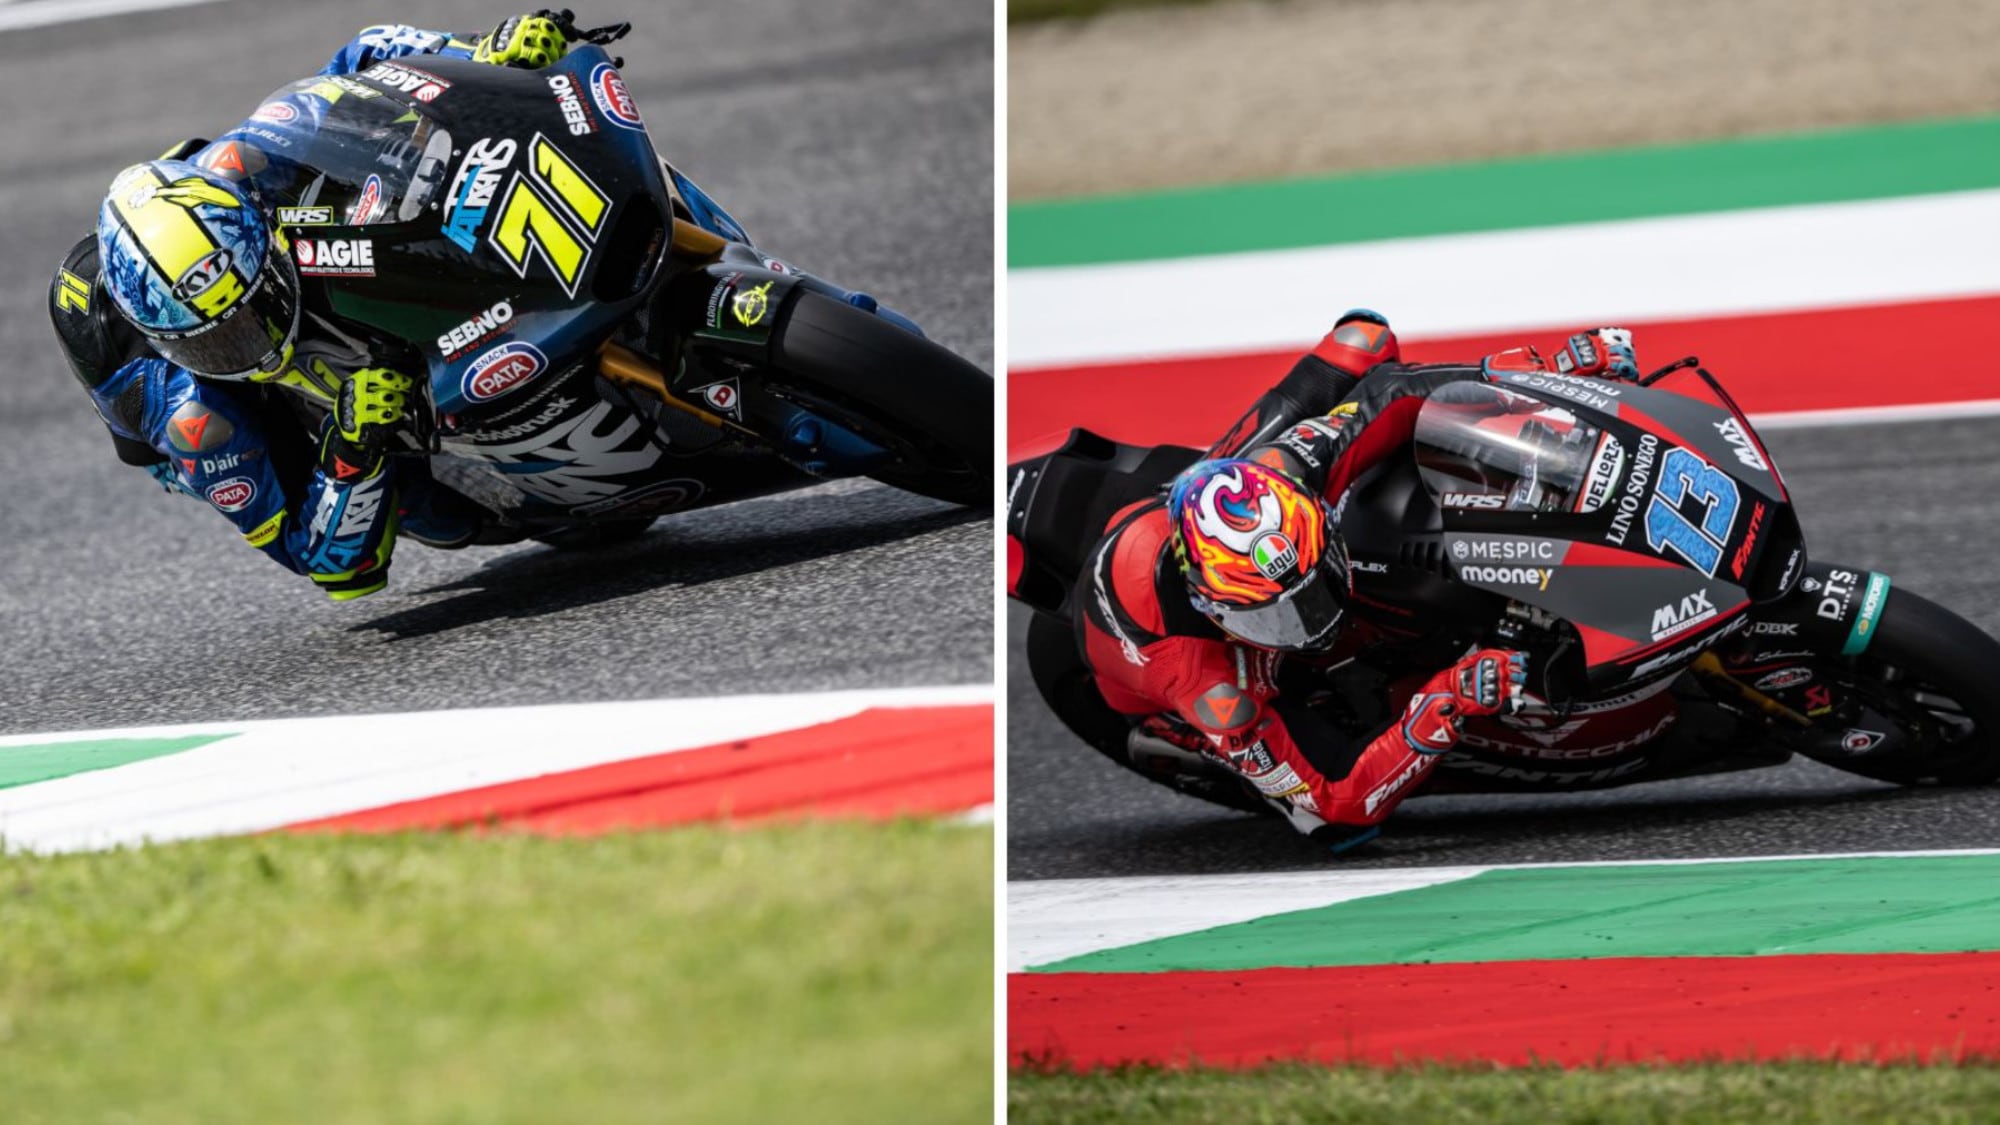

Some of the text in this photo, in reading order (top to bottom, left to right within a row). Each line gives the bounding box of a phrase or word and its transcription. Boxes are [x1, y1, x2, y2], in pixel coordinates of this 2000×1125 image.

[361, 64, 427, 92] AGIE
[280, 208, 330, 223] WRS
[488, 131, 613, 300] 71
[315, 239, 375, 267] AGIE
[56, 266, 91, 316] 71
[180, 254, 226, 299] KYT
[475, 346, 508, 371] SNACK
[478, 360, 531, 394] PATA
[1529, 377, 1609, 409] MESPIC
[215, 487, 246, 503] PATA
[1443, 493, 1506, 508] WRS
[1605, 433, 1659, 545] LINO SONEGO
[1644, 446, 1741, 580] 13
[1265, 549, 1293, 576] agv
[1472, 541, 1552, 559] MESPIC
[1461, 565, 1553, 591] mooney
[1816, 569, 1853, 621] DTS
[1650, 587, 1715, 635] MAX
[1754, 621, 1800, 636] DBK
[1460, 713, 1678, 761] OTTECCHIA
